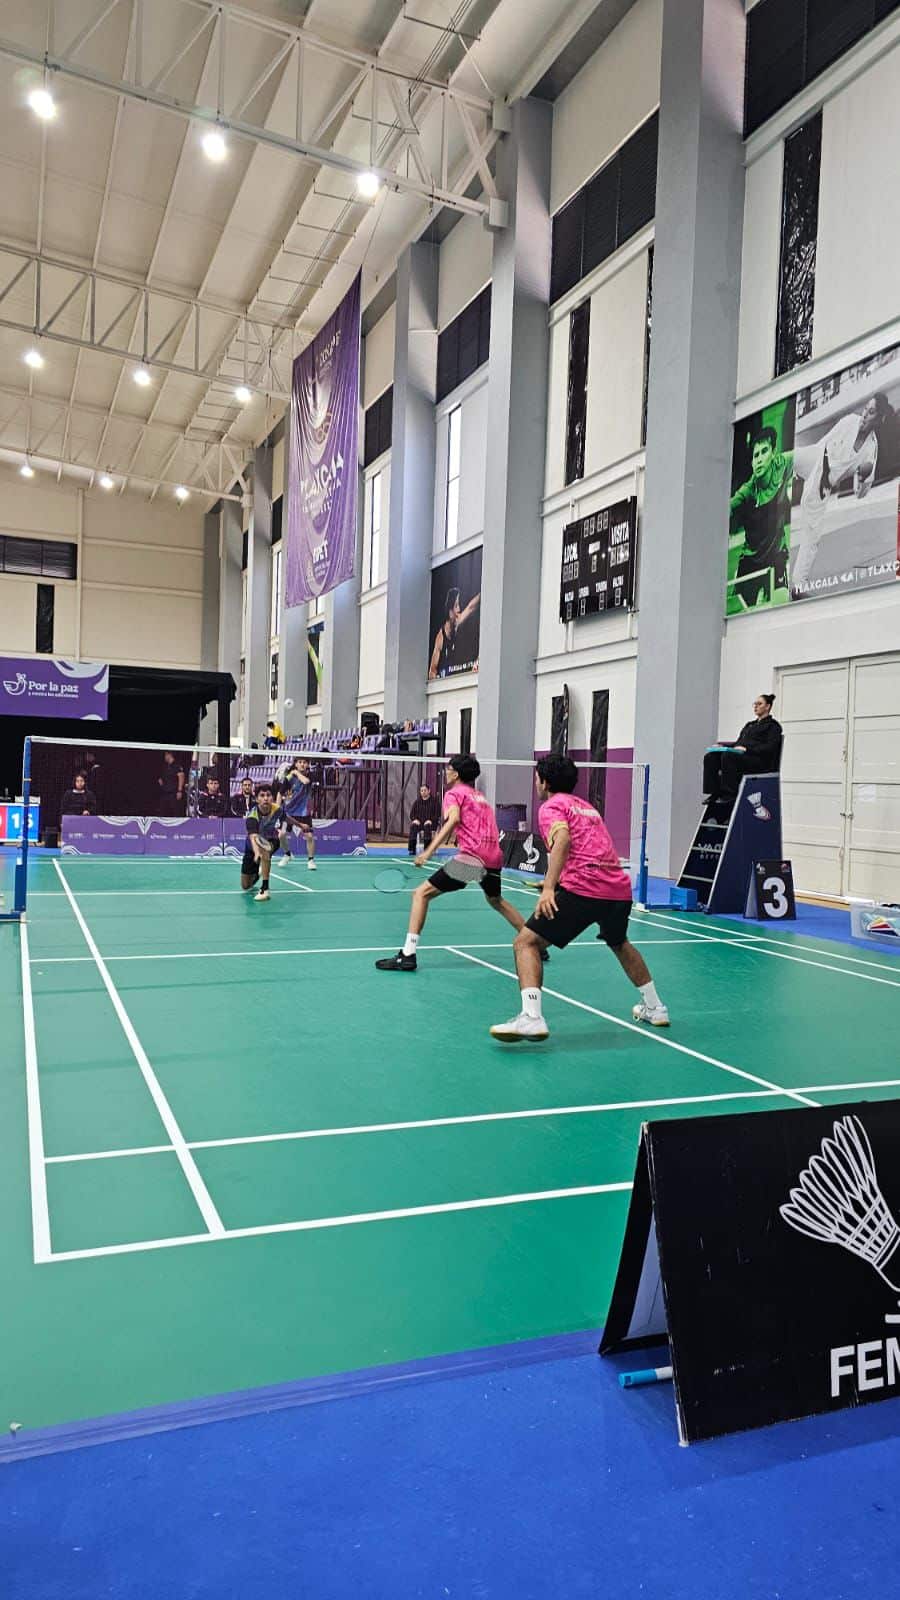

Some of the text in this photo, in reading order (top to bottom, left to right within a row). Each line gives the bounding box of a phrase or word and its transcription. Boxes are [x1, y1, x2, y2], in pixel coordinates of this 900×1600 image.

[793, 574, 839, 595] TLAXCALA
[28, 680, 79, 694] Por la paz
[763, 876, 788, 918] 3
